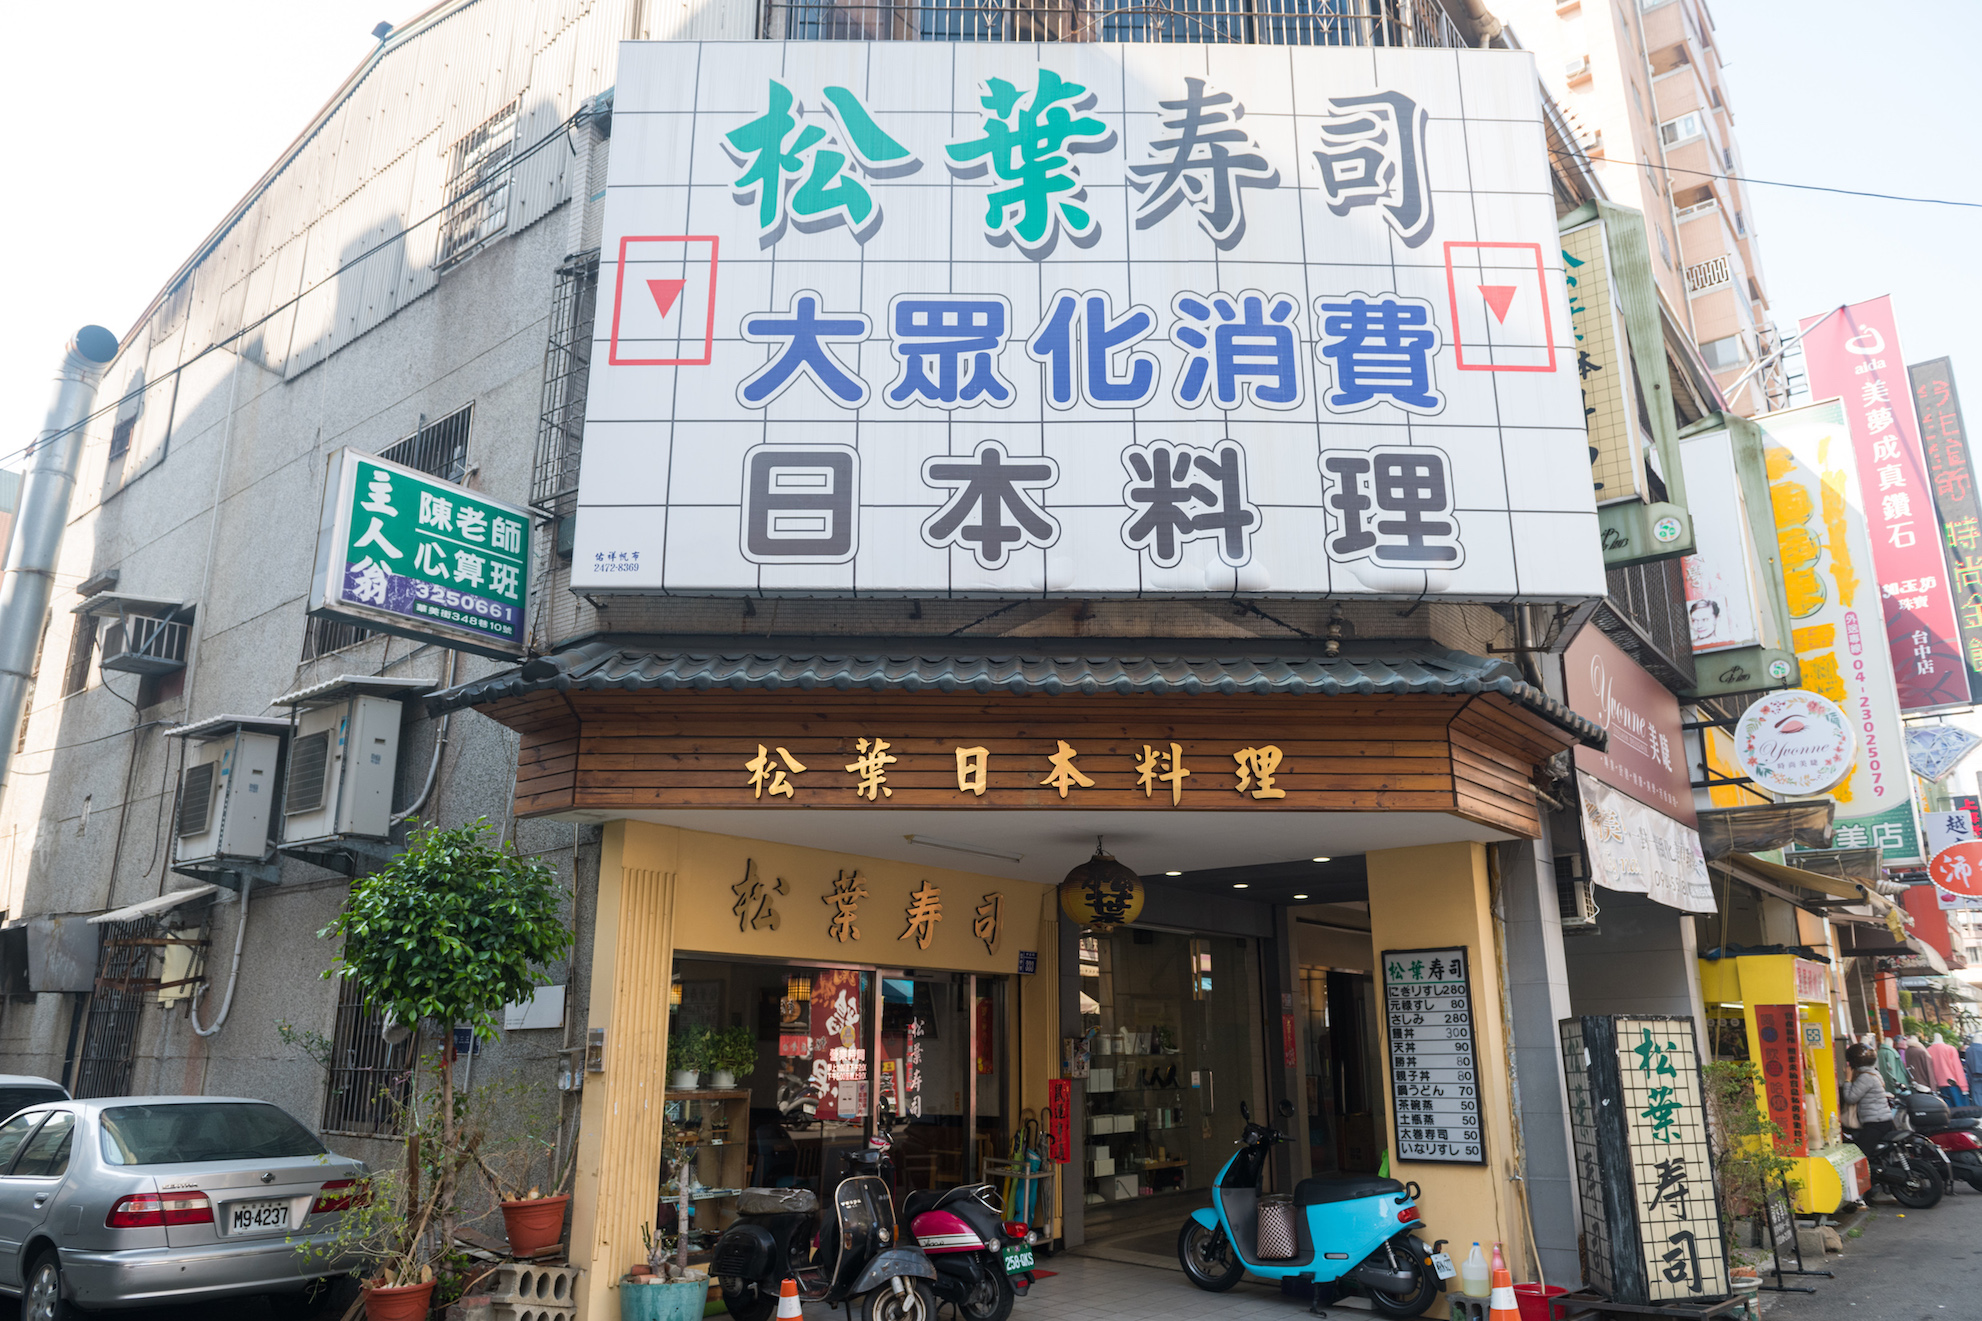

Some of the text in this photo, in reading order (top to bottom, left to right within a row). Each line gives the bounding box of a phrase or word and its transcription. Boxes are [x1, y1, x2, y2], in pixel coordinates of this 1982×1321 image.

[725, 67, 1435, 260] 松葉寿司
[738, 289, 1444, 415] 大眾化消費
[1861, 378, 1916, 549] 美夢成真鑽石
[739, 440, 1464, 569] 日本料理
[419, 490, 522, 554] 陳老師
[351, 470, 403, 604] 主人翁
[414, 541, 519, 600] 心算班
[594, 563, 639, 572] 2472-8369
[416, 583, 512, 621] 3250661
[416, 603, 513, 635] 華美街348巷10號
[1911, 630, 1934, 675] 台中店
[1591, 655, 1646, 738] Yvonne
[1853, 660, 1885, 797] 04-23025079
[1759, 739, 1830, 764] Yvonne
[745, 737, 1287, 806] 松葉日本料理
[1388, 957, 1462, 981] 松葉寿司
[1451, 999, 1465, 1009] 80
[1391, 1013, 1467, 1025] さしみ 280
[1446, 1027, 1467, 1038] 300
[1394, 1042, 1469, 1053] 天丼 90
[1457, 1056, 1470, 1066] 80
[1396, 1070, 1472, 1081] 親子丼 80
[1397, 1084, 1473, 1096] 鍋うどん 70
[1461, 1101, 1475, 1110] 50
[1462, 1116, 1476, 1125] 50
[1464, 1131, 1477, 1140] 50
[1401, 1143, 1479, 1155] いなりすし 50
[1634, 1027, 1703, 1293] 松葉寿司
[234, 1207, 288, 1229] M9-4237
